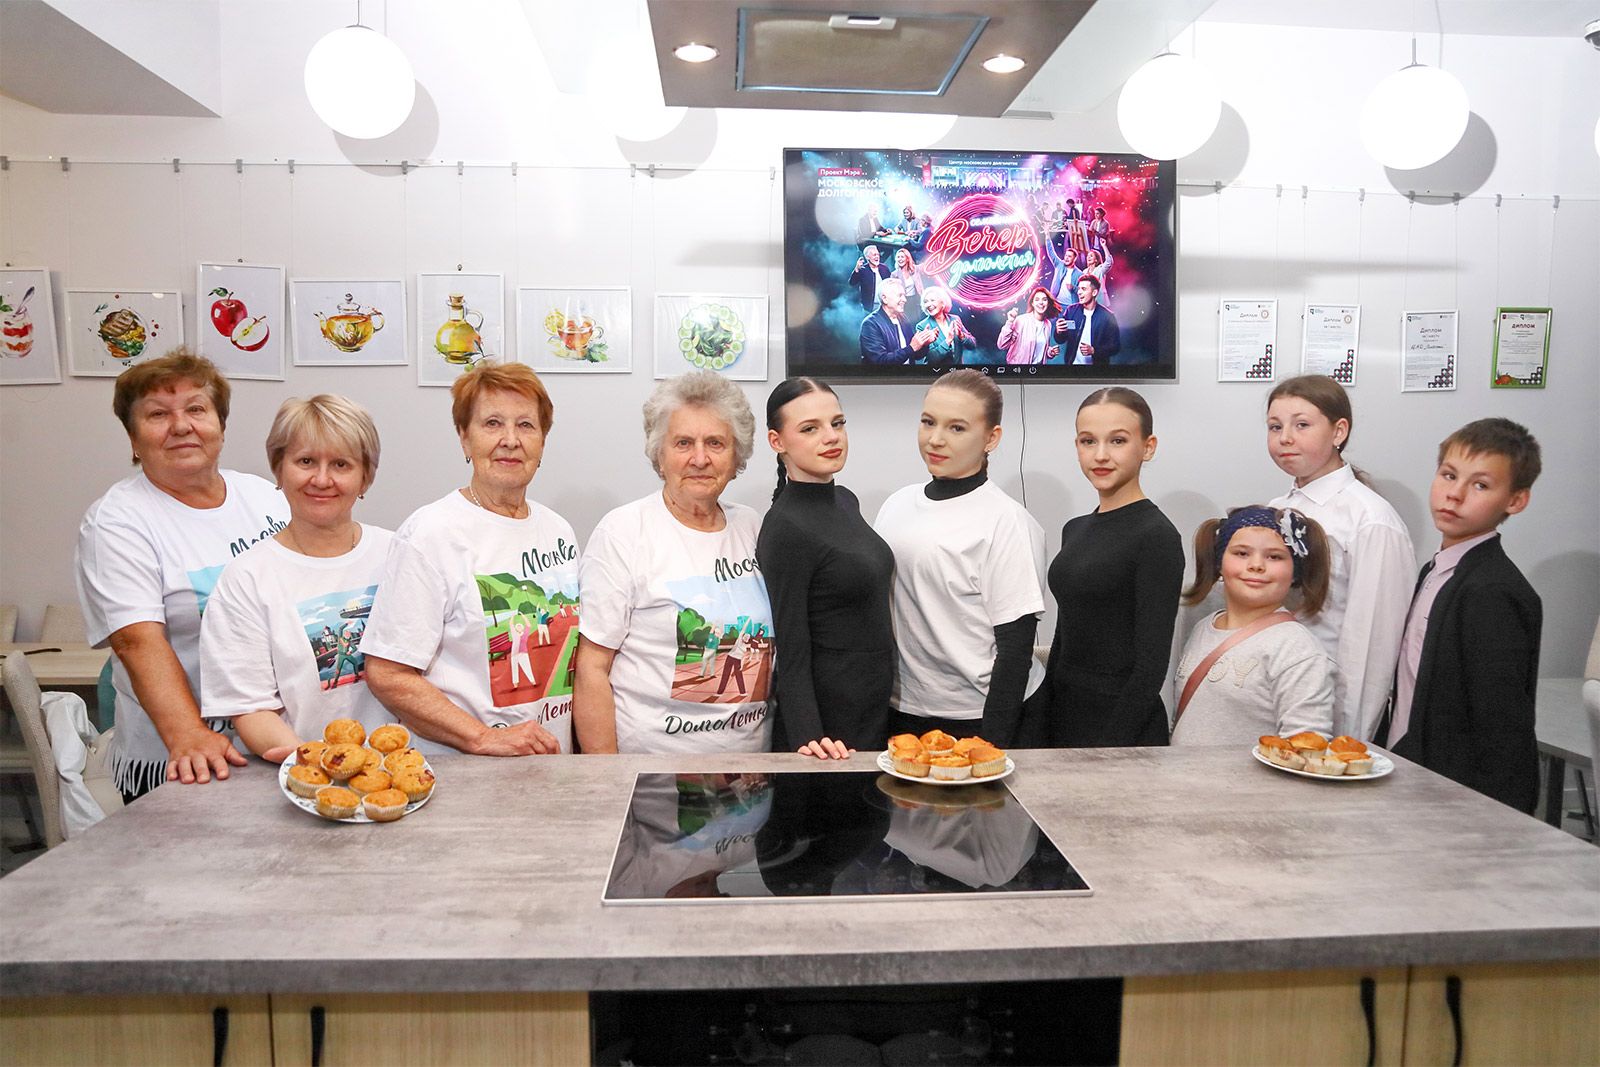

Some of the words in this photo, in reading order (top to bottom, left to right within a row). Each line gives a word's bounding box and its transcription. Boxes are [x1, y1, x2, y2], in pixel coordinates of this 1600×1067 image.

[820, 168, 843, 177] Проект
[843, 168, 861, 177] Мэра
[817, 178, 884, 189] МОСКОВСКОЕ
[923, 218, 1033, 276] Вечер
